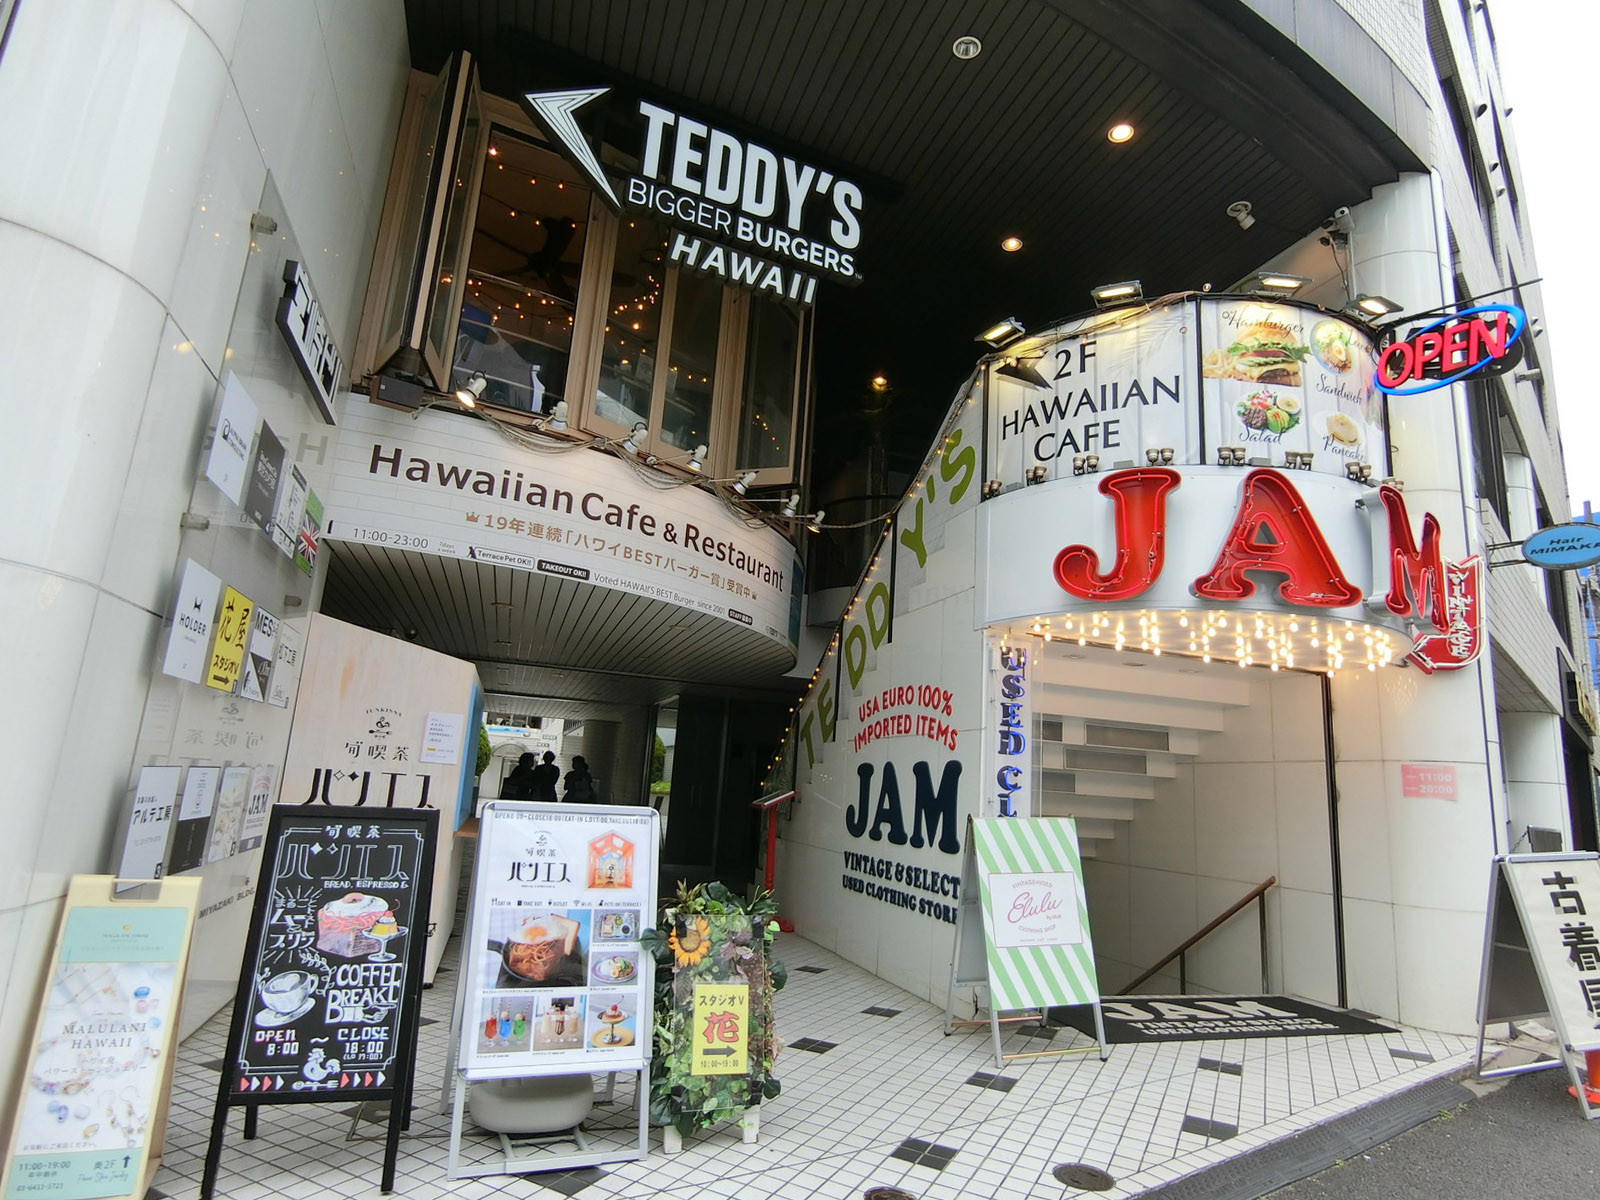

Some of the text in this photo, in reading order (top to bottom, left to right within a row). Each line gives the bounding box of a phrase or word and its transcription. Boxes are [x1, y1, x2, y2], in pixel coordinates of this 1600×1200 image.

[638, 100, 864, 250] TEDDY'S
[628, 177, 855, 277] BIGGER BURGERS
[670, 233, 817, 303] HAWAII
[1227, 304, 1305, 340] Hamburger
[1053, 340, 1098, 382] 2F
[1377, 311, 1508, 388] OPEN
[1001, 374, 1181, 441] HAWAIIAN
[1316, 373, 1362, 406] Sandwich
[1033, 419, 1122, 462] CAFE
[1238, 424, 1287, 445] Salad
[369, 444, 573, 514] Hawaiian
[581, 492, 657, 537] Cafe
[663, 523, 678, 541] &
[684, 525, 784, 593] Restaurant
[352, 528, 429, 549] 11:00-23:00
[477, 550, 505, 561] Terrace
[505, 554, 516, 563] Pet
[1053, 466, 1450, 635] JAM
[1549, 537, 1584, 546] Hair
[541, 562, 573, 576] TAKEOUT
[594, 572, 618, 586] Voted
[656, 587, 673, 600] BEST
[674, 593, 695, 607] Burger
[801, 428, 976, 769] TEDDY'S
[179, 614, 207, 636] HOLDER
[219, 597, 251, 650] 花屋
[858, 684, 954, 723] USA EURO 100%
[998, 645, 1027, 756] USED
[854, 714, 958, 753] IMPORTED ITEMS
[247, 793, 268, 815] JAM
[845, 759, 963, 855] JAM
[356, 879, 400, 889] ESPRESSO
[842, 874, 864, 894] USED
[866, 881, 917, 912] CLOTHING
[844, 851, 961, 900] VINTAGE & SELECT
[1007, 891, 1064, 924] Elulu
[336, 962, 403, 1001] COFFEE
[699, 994, 744, 1007] スタジオV
[325, 986, 389, 1024] BREAK
[1101, 1000, 1299, 1021] JAM
[62, 1022, 147, 1035] MALULANI
[71, 1037, 132, 1050] HAWAII
[254, 1026, 390, 1043] OPEN CLOSE
[266, 1041, 384, 1056] 8:00 18:00
